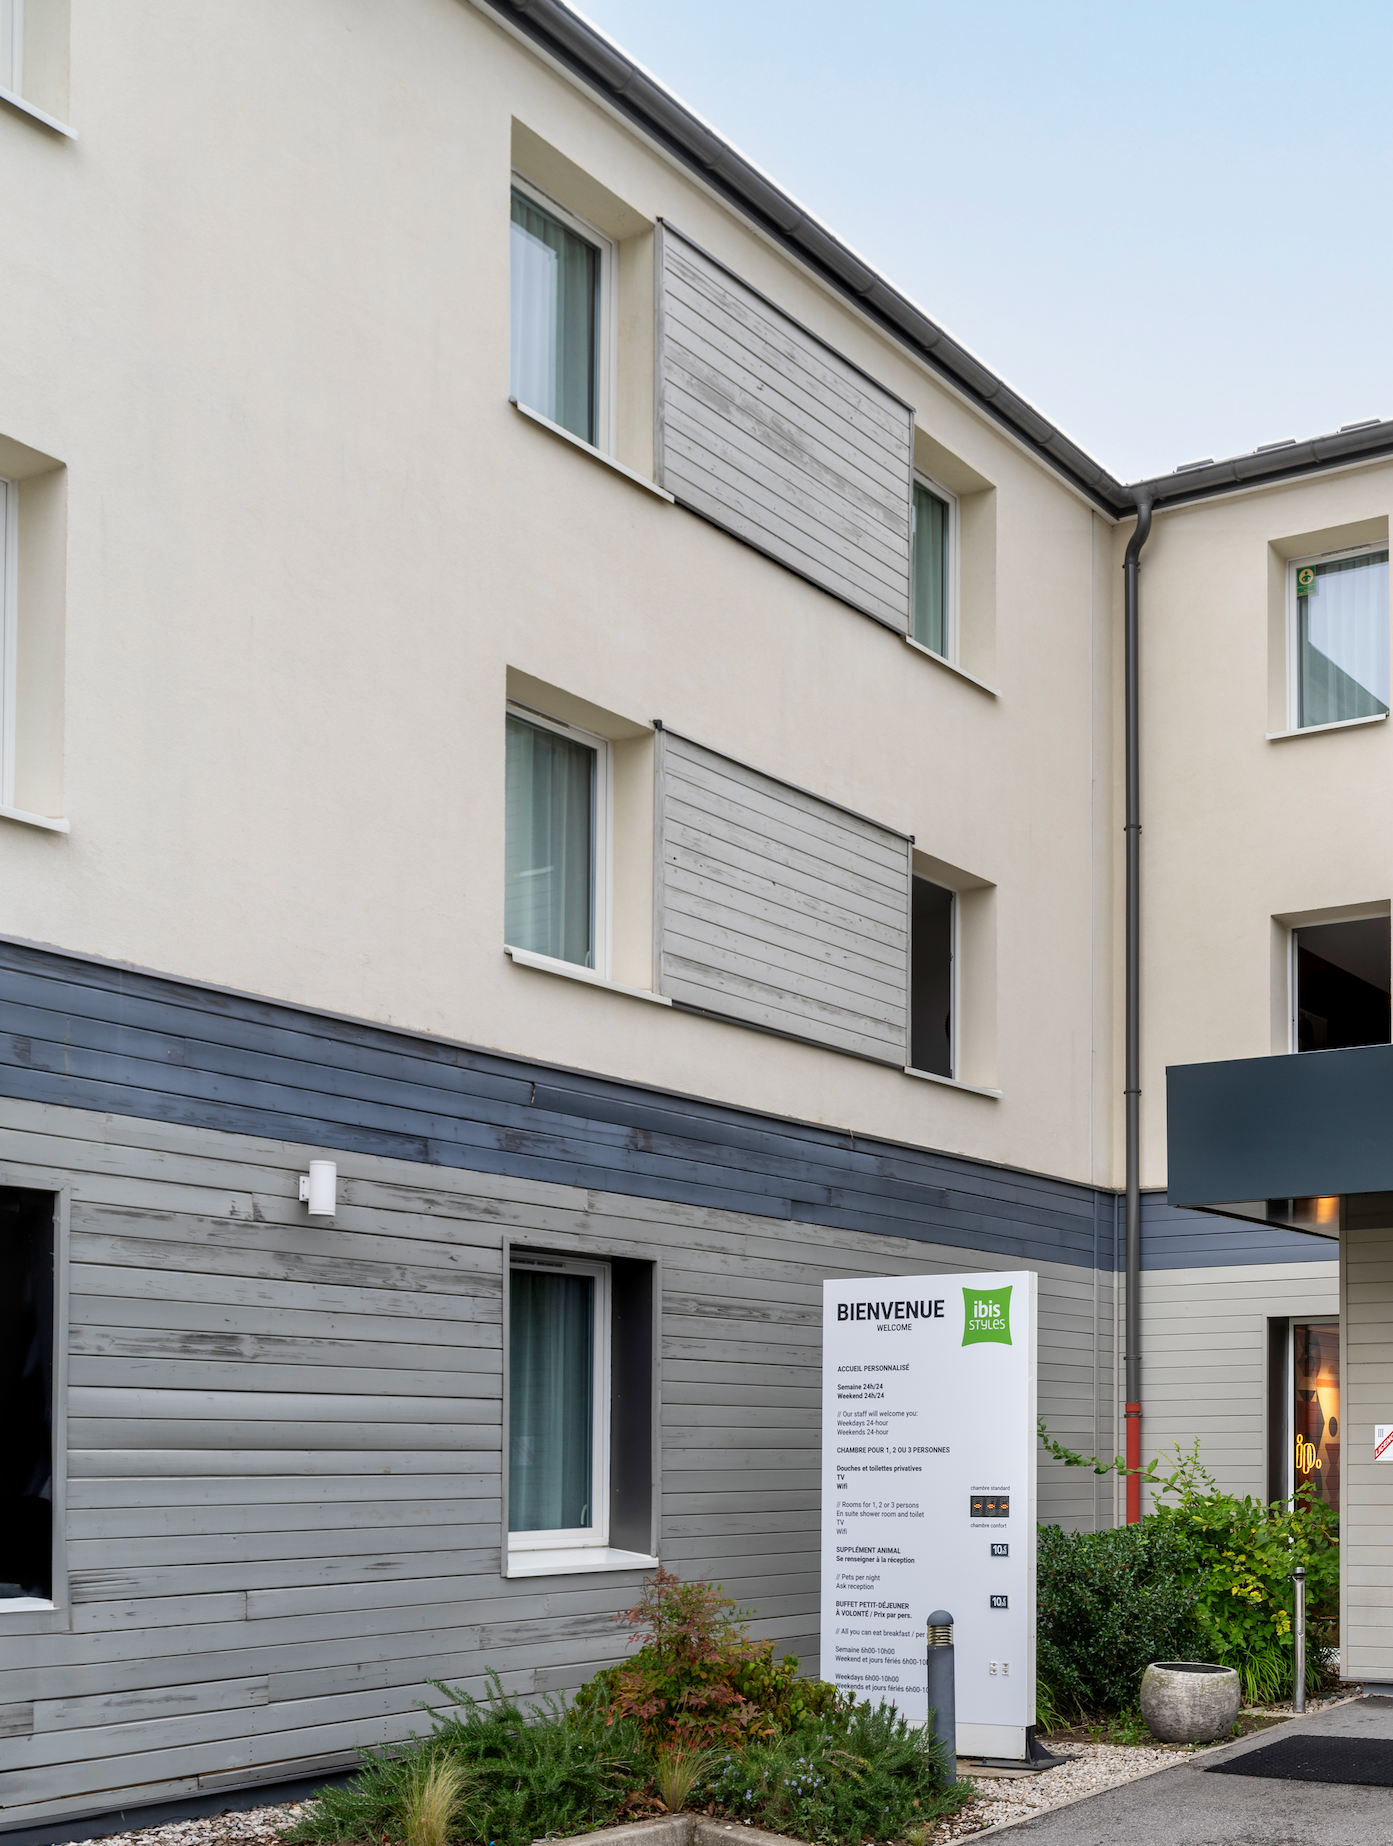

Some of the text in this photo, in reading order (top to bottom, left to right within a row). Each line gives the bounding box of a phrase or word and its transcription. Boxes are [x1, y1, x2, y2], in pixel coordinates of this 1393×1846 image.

[837, 1299, 945, 1321] BIENVENUE
[973, 1300, 1001, 1318] ibis
[877, 1323, 912, 1332] WELCOME
[864, 1363, 910, 1372] PERSONNALISÉ
[837, 1419, 865, 1427] Weekdays
[894, 1465, 922, 1473] privatives
[845, 1556, 875, 1564] renseigner
[866, 1574, 880, 1582] night
[848, 1583, 874, 1591] reception
[859, 1601, 909, 1609] PETIT-DÉJEUNER
[841, 1609, 869, 1617] VOLONTÉ
[869, 1656, 883, 1664] jours
[835, 1673, 863, 1681] Weekdays
[872, 1684, 886, 1692] jours
